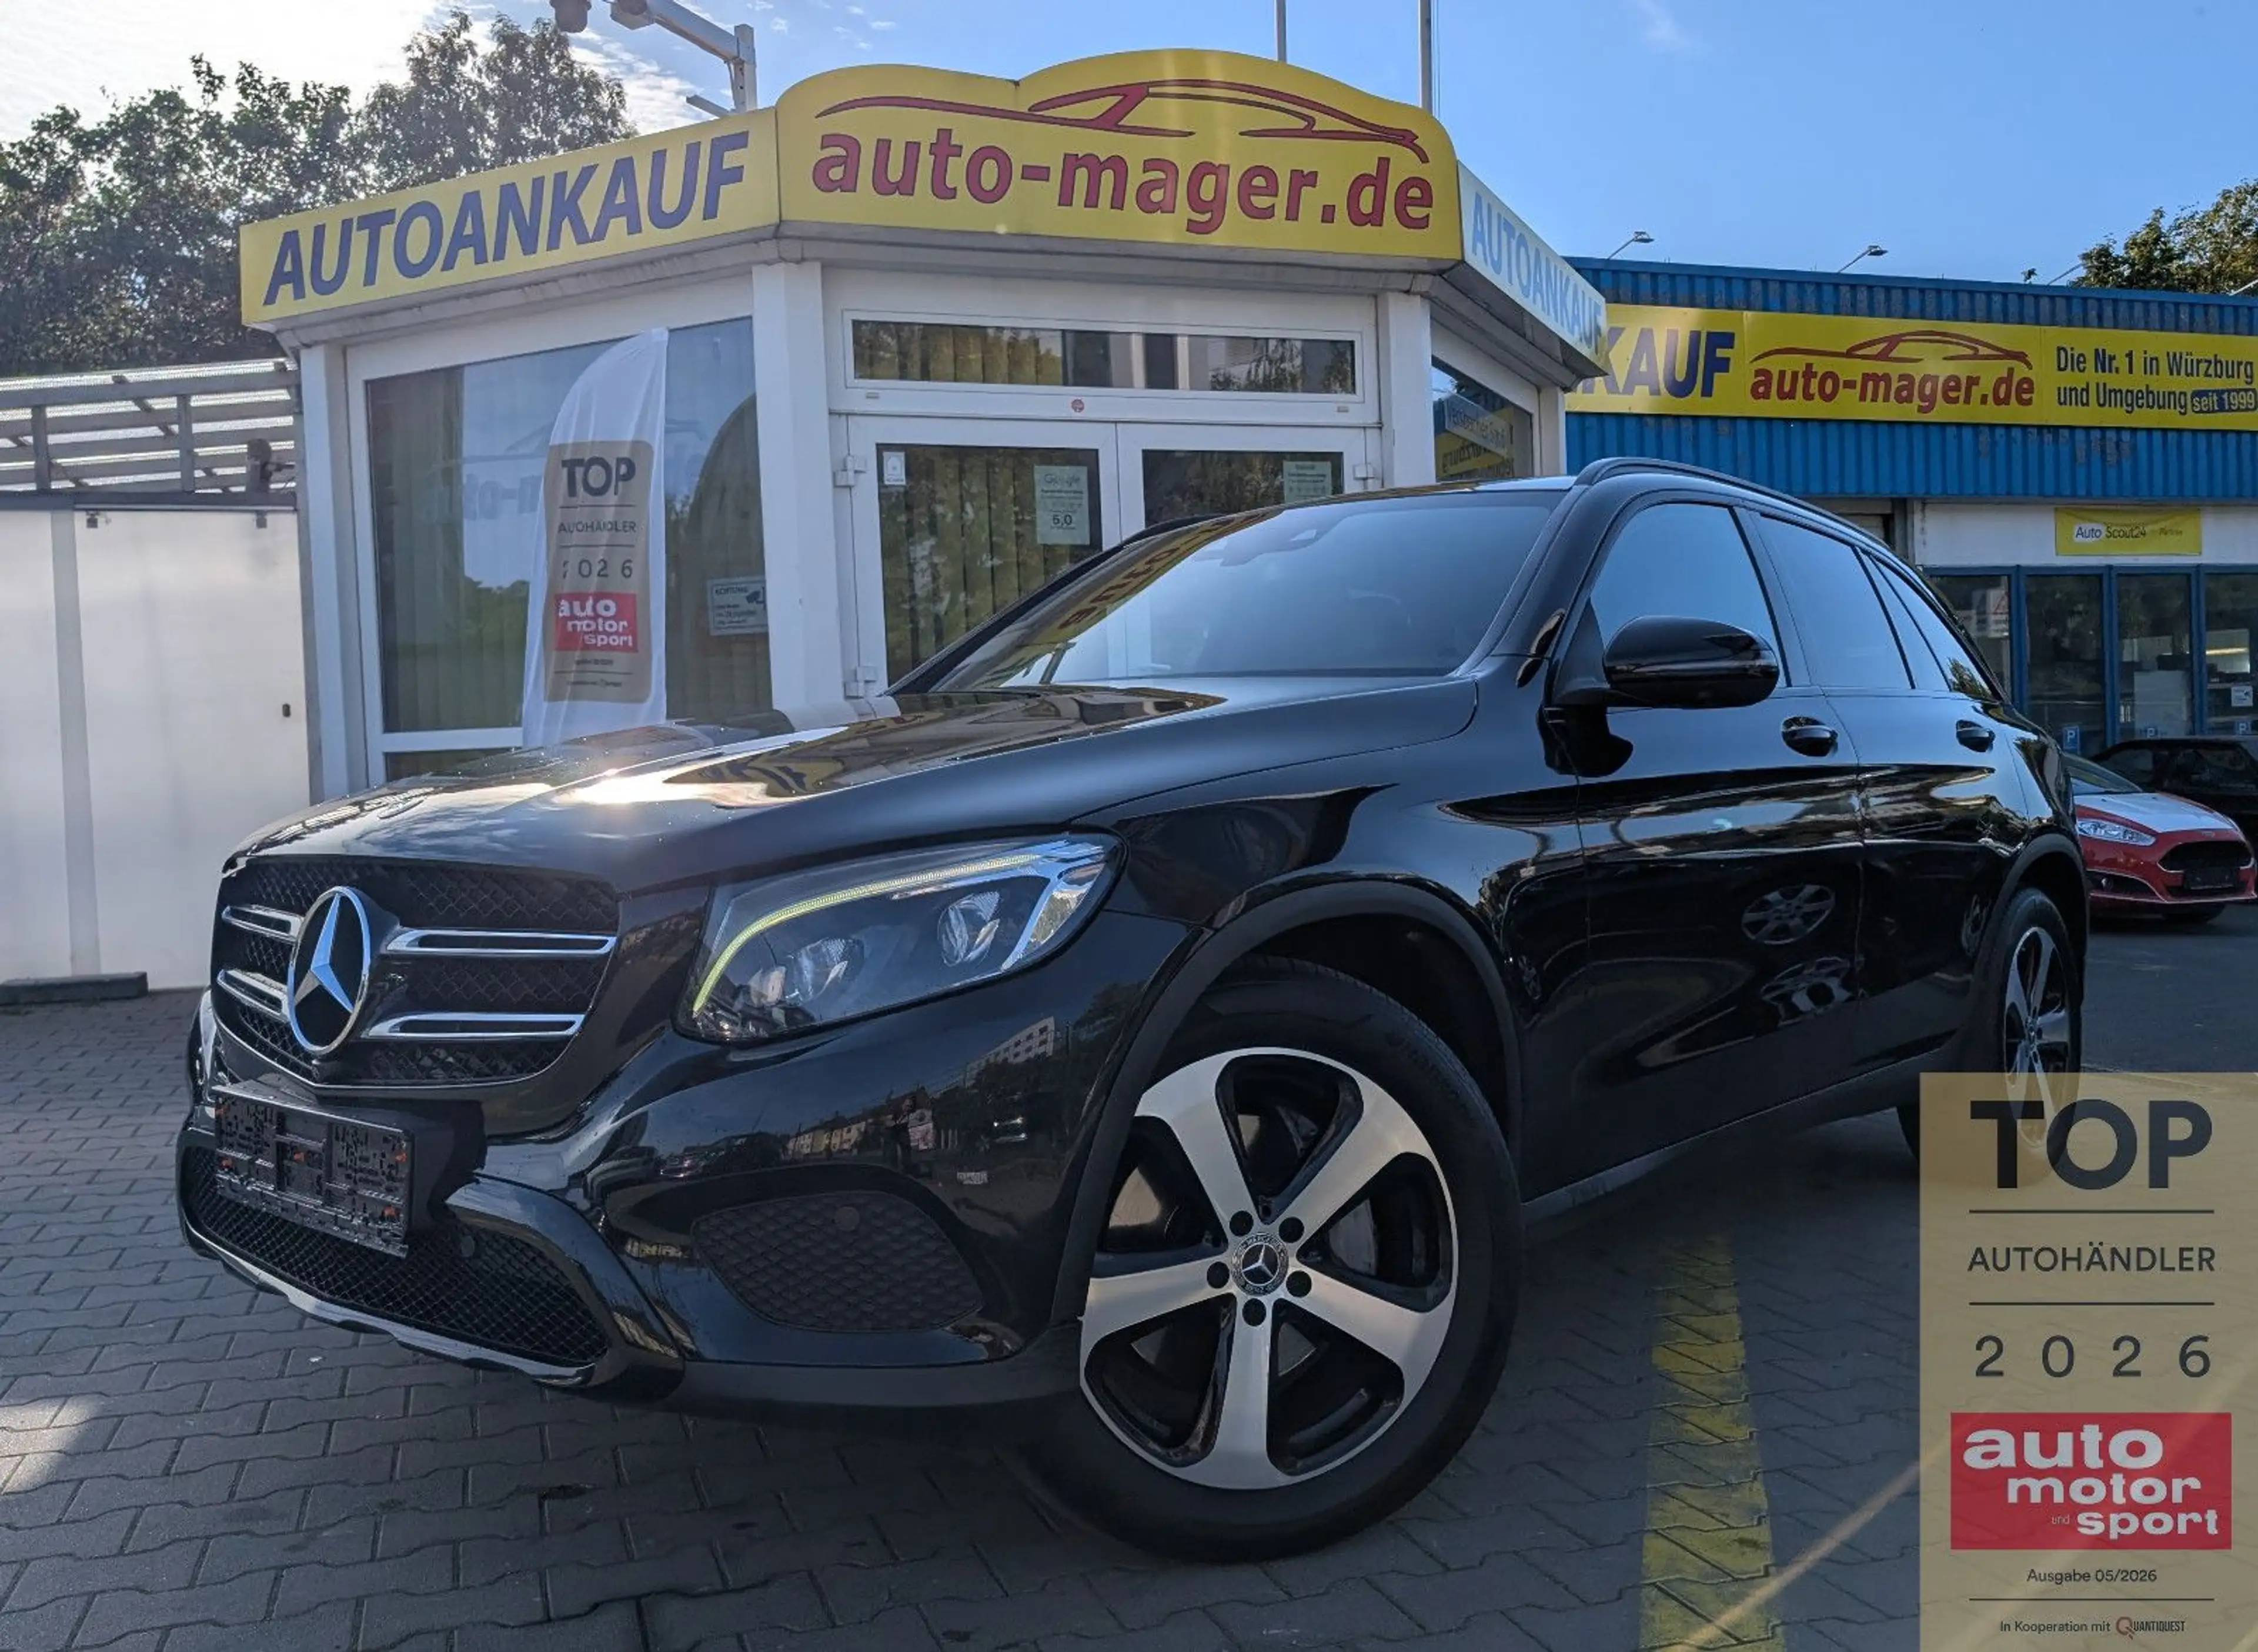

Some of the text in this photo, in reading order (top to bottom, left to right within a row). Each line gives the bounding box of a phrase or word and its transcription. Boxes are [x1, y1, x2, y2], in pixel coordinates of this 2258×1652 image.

[812, 128, 1433, 234] auto-mager.de
[263, 131, 749, 306] AUTOANKAUF
[1472, 192, 1602, 356] AUTOANKAUF
[2056, 346, 2254, 384] Die Nr. 1 in Würzburg
[1750, 363, 2035, 413] auto-mager.de
[2057, 382, 2255, 415] und Umgebung seit 1999
[562, 456, 636, 497] TOP
[2076, 527, 2102, 539] Auto
